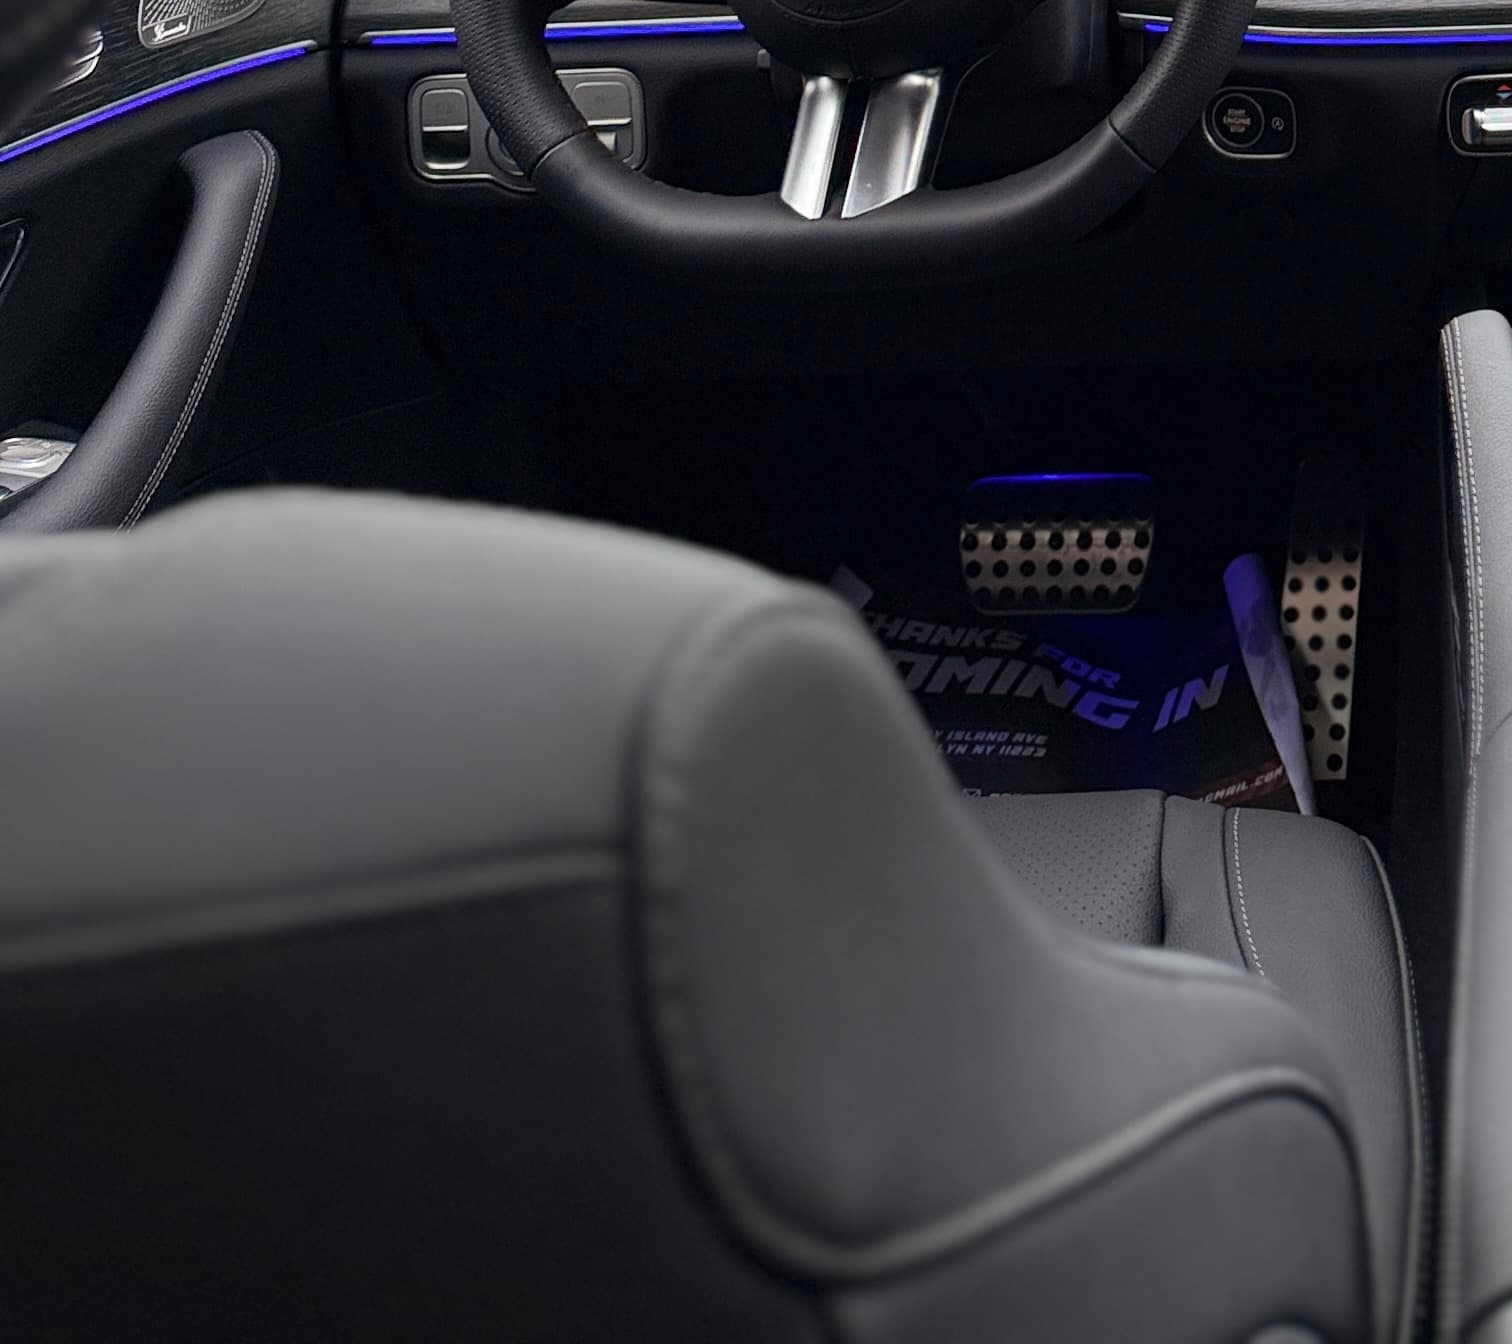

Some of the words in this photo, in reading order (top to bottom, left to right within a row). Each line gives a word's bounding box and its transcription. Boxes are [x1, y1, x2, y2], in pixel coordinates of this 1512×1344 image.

[866, 613, 1028, 651] HANKS
[1034, 641, 1122, 689] FOR
[885, 649, 1142, 730] OMING
[1151, 664, 1230, 733] IN
[946, 730, 1010, 742] ISLAND
[1012, 731, 1049, 744] AVE
[971, 745, 996, 756] NY
